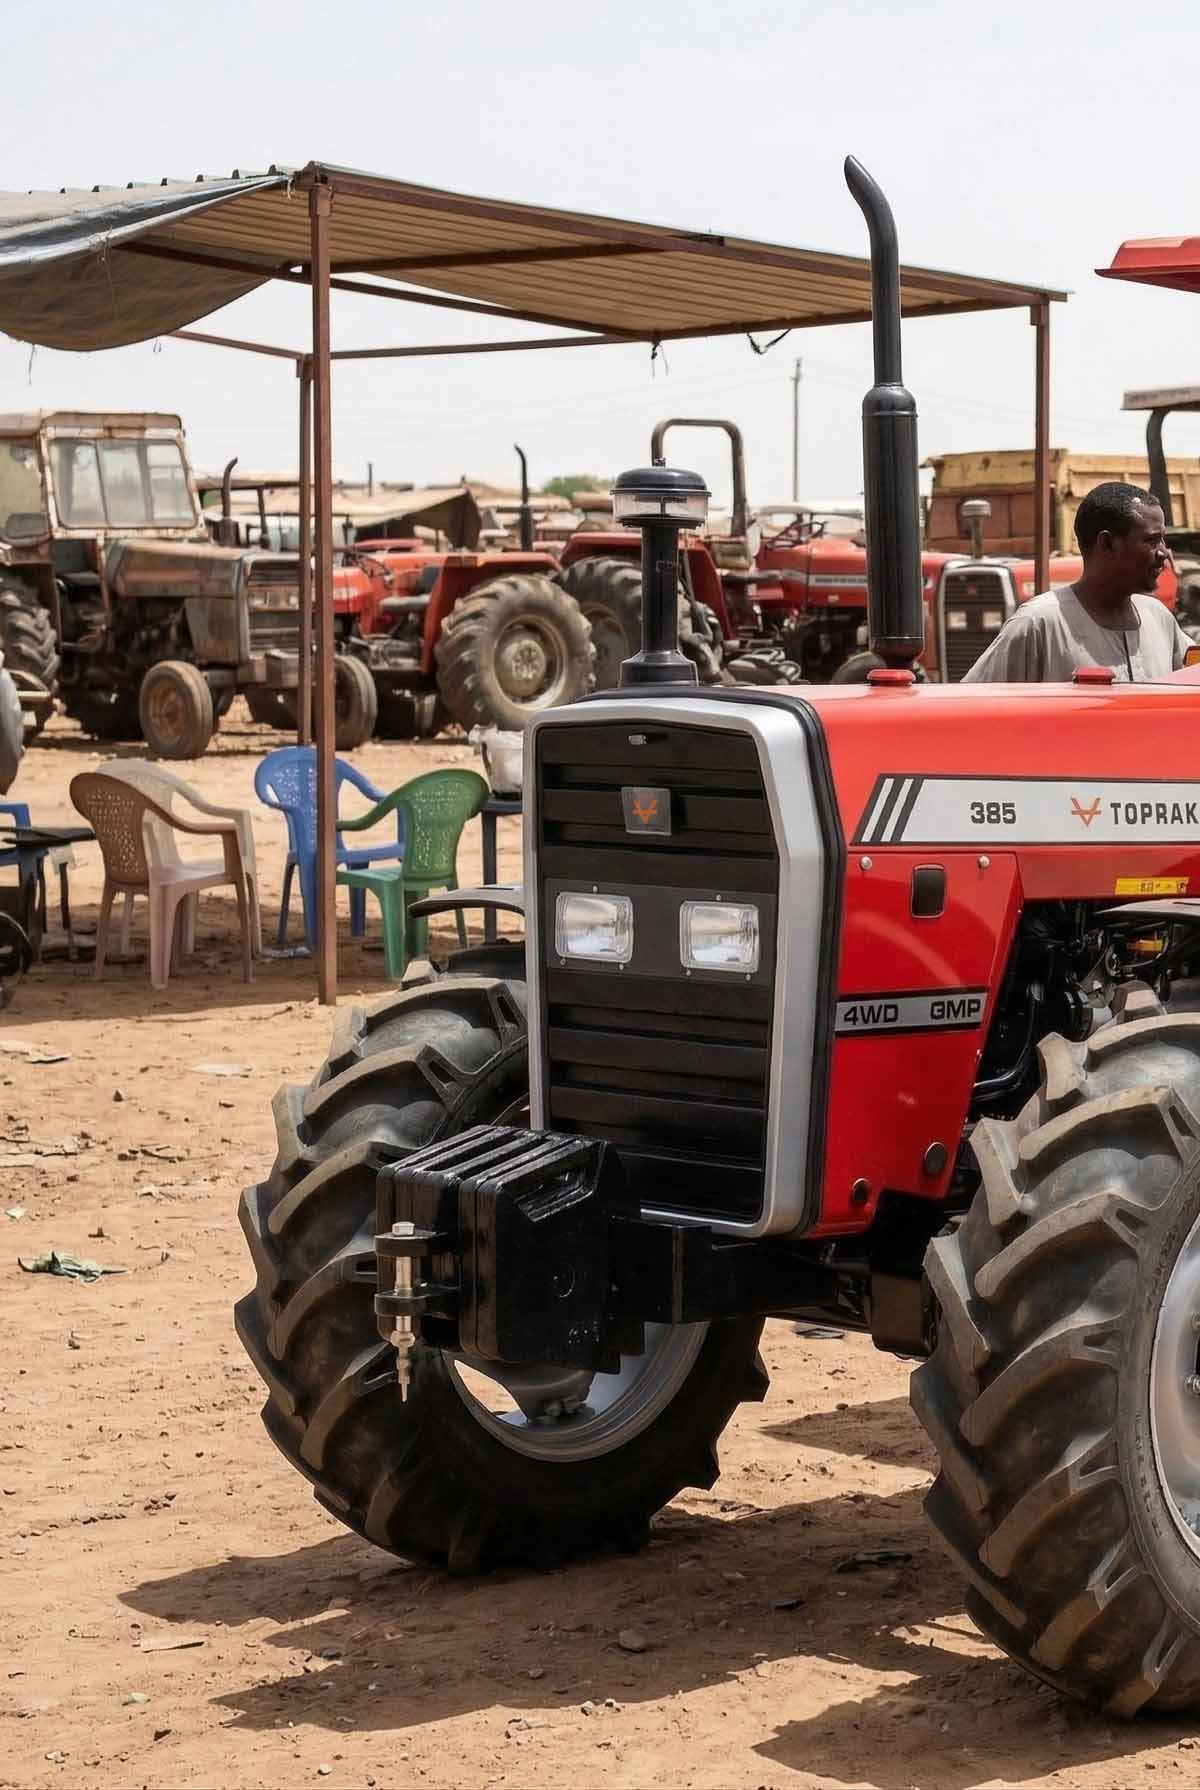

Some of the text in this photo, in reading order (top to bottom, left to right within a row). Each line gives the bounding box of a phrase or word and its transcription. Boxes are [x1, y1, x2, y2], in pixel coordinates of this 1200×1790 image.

[970, 801, 1199, 825] 385 TOPRAK
[843, 998, 981, 1026] 4WD GMP
